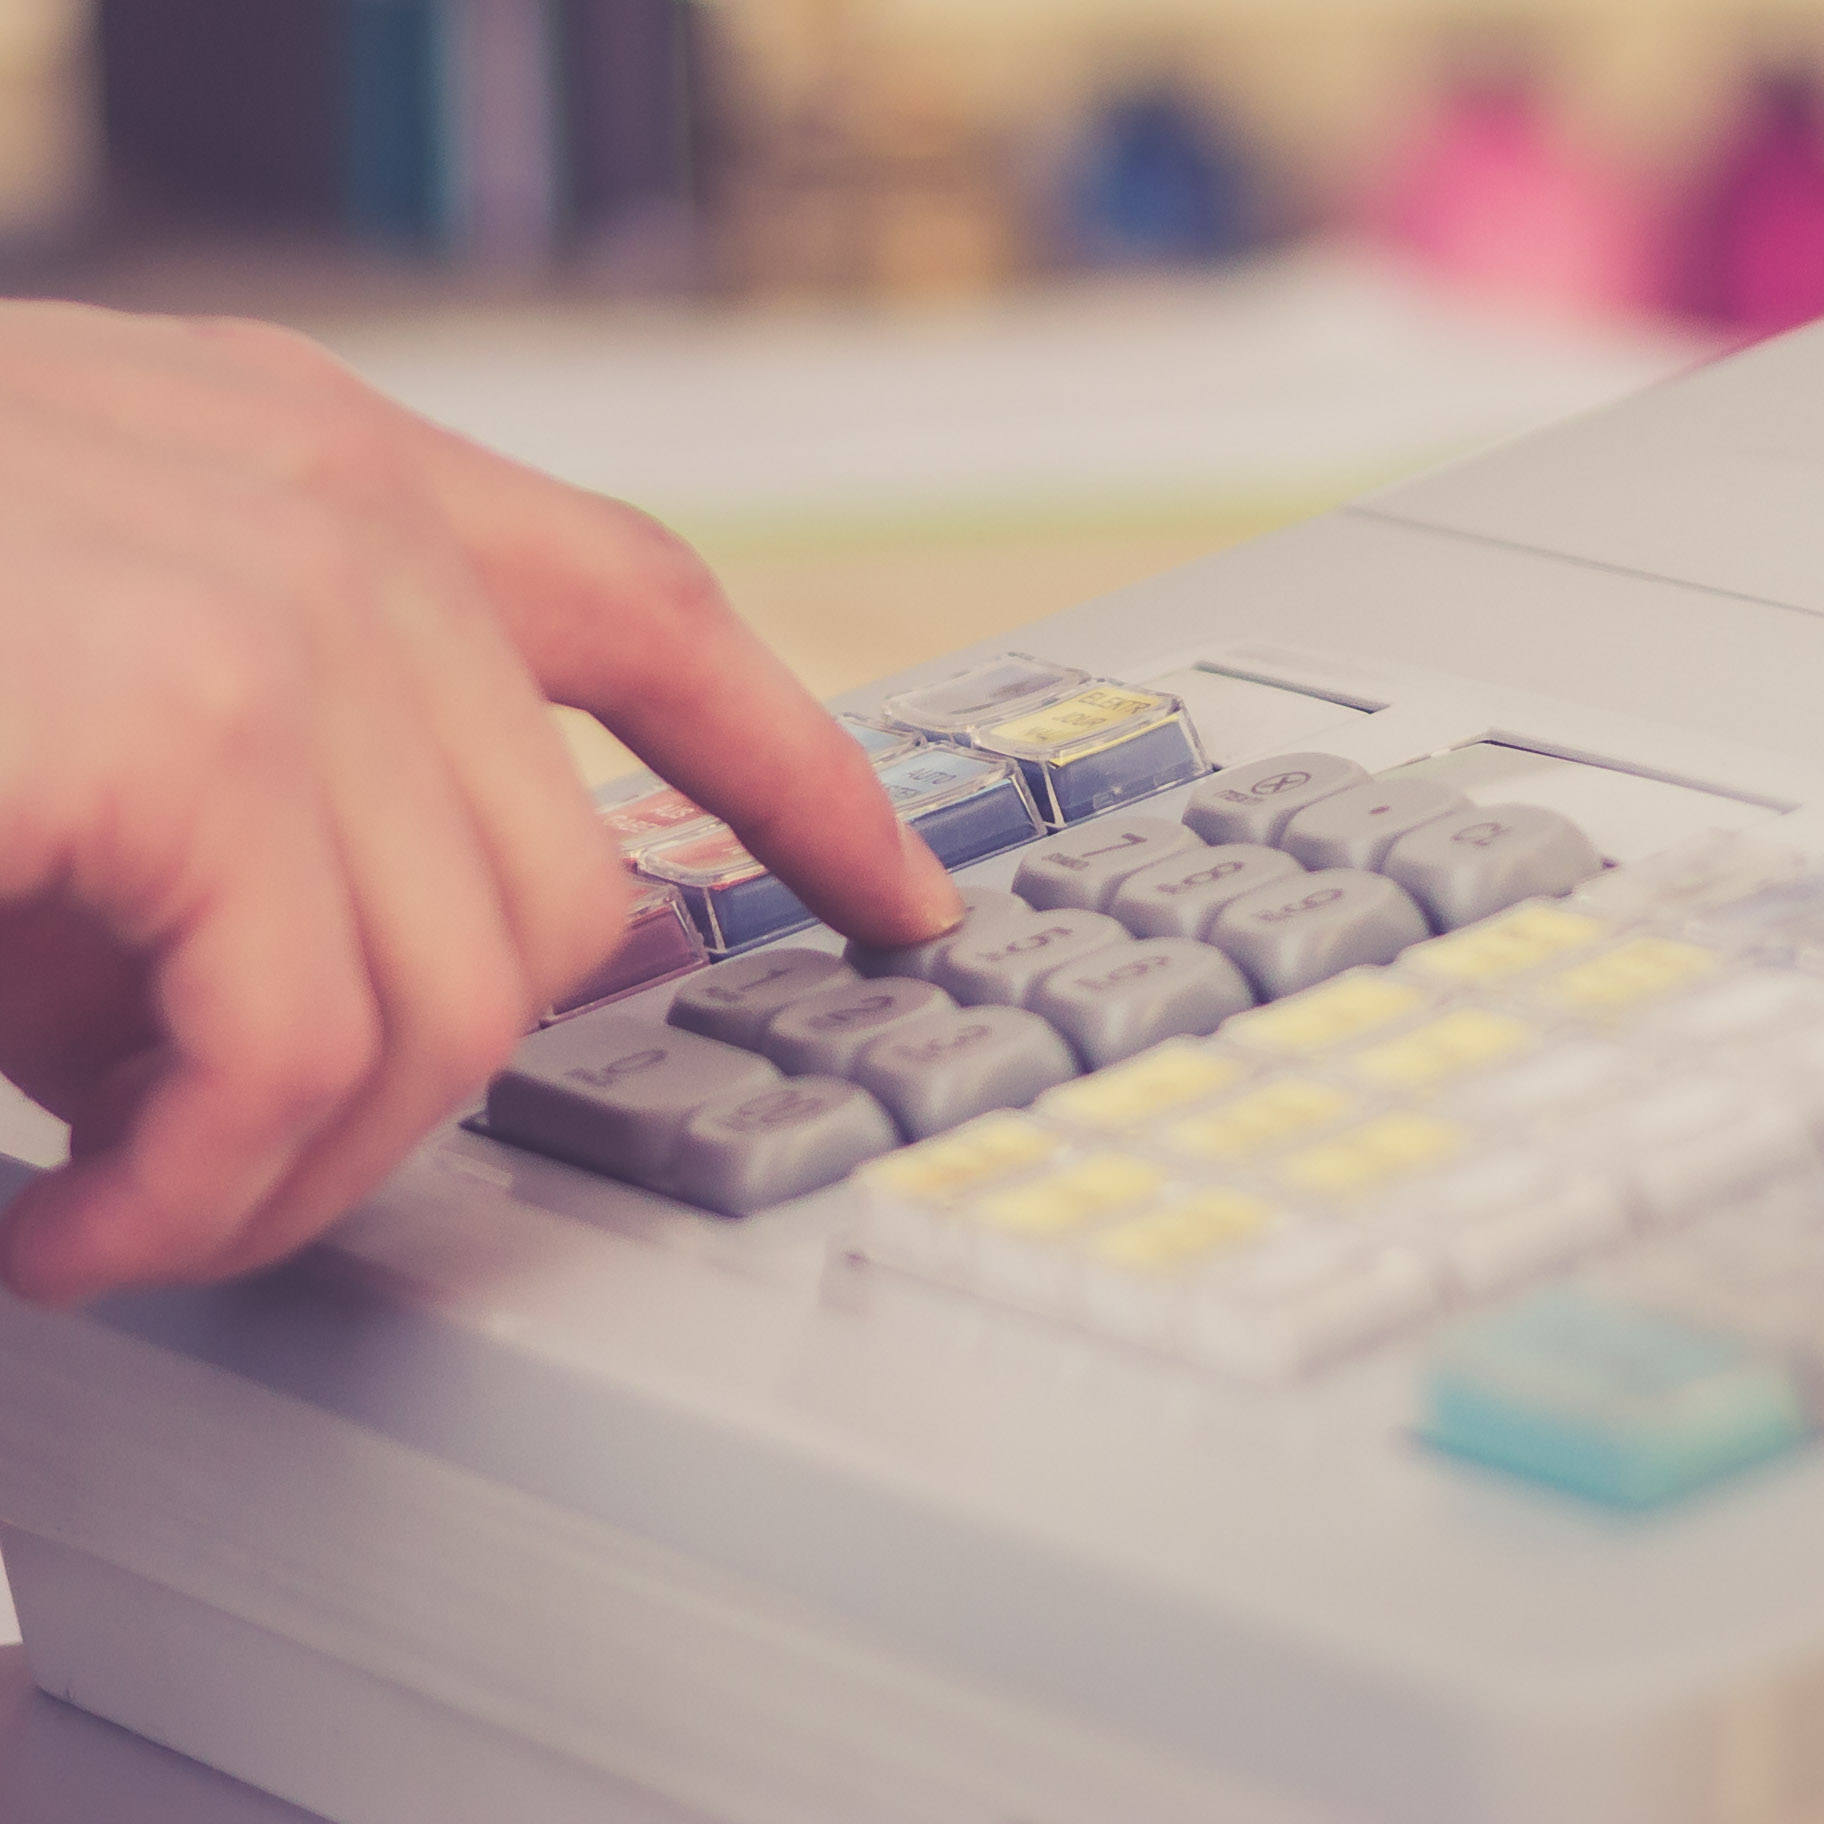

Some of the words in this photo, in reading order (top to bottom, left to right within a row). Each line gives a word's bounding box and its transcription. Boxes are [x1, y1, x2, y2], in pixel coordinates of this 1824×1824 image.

[1080, 832, 1148, 858] 7
[1182, 861, 1244, 885] 8
[1280, 887, 1343, 914] 9
[1006, 926, 1072, 953] 5
[736, 967, 793, 991] 1
[828, 995, 894, 1021] 2
[605, 1049, 667, 1075] 0
